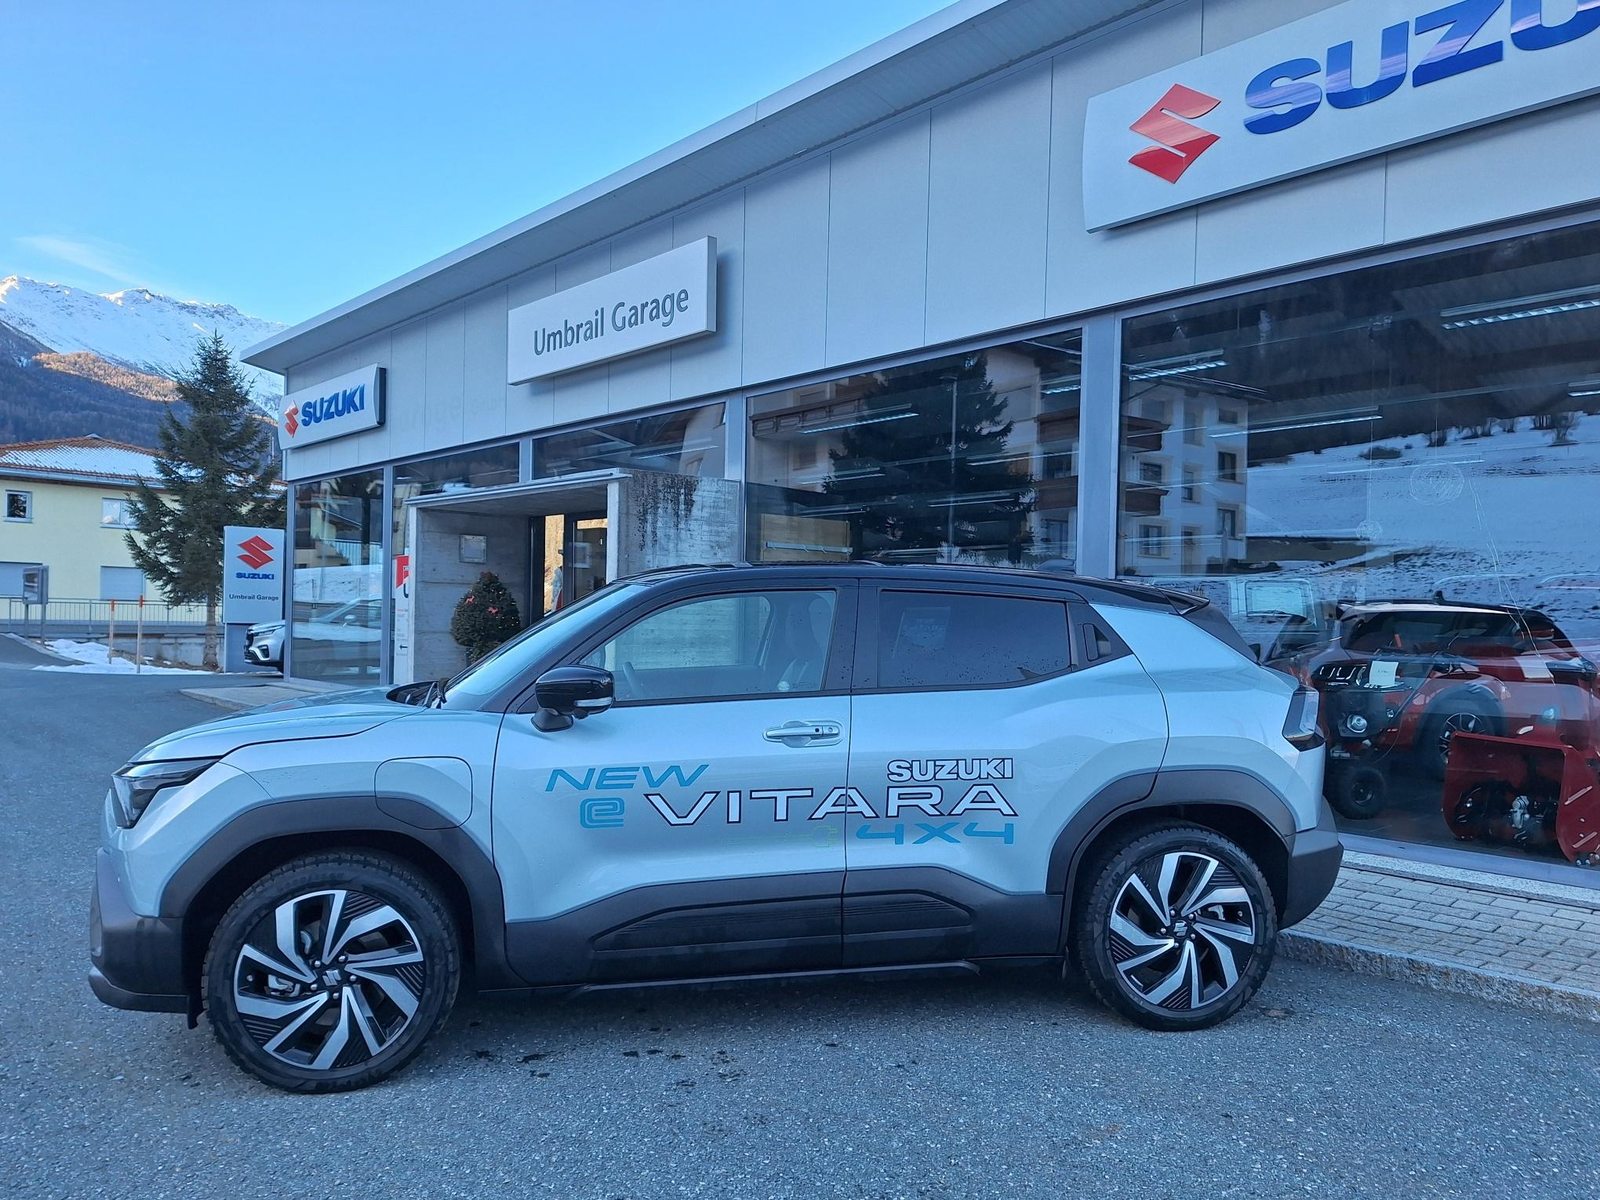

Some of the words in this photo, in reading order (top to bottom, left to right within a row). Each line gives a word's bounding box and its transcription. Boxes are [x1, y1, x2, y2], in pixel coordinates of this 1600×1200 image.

[533, 307, 605, 356] Umbrail
[611, 288, 689, 332] Garage
[301, 384, 366, 427] SUZUKI
[235, 572, 275, 580] SUZUKI
[545, 764, 709, 792] NEW
[887, 758, 1014, 783] SUZUKI
[643, 784, 1019, 826] VITARA
